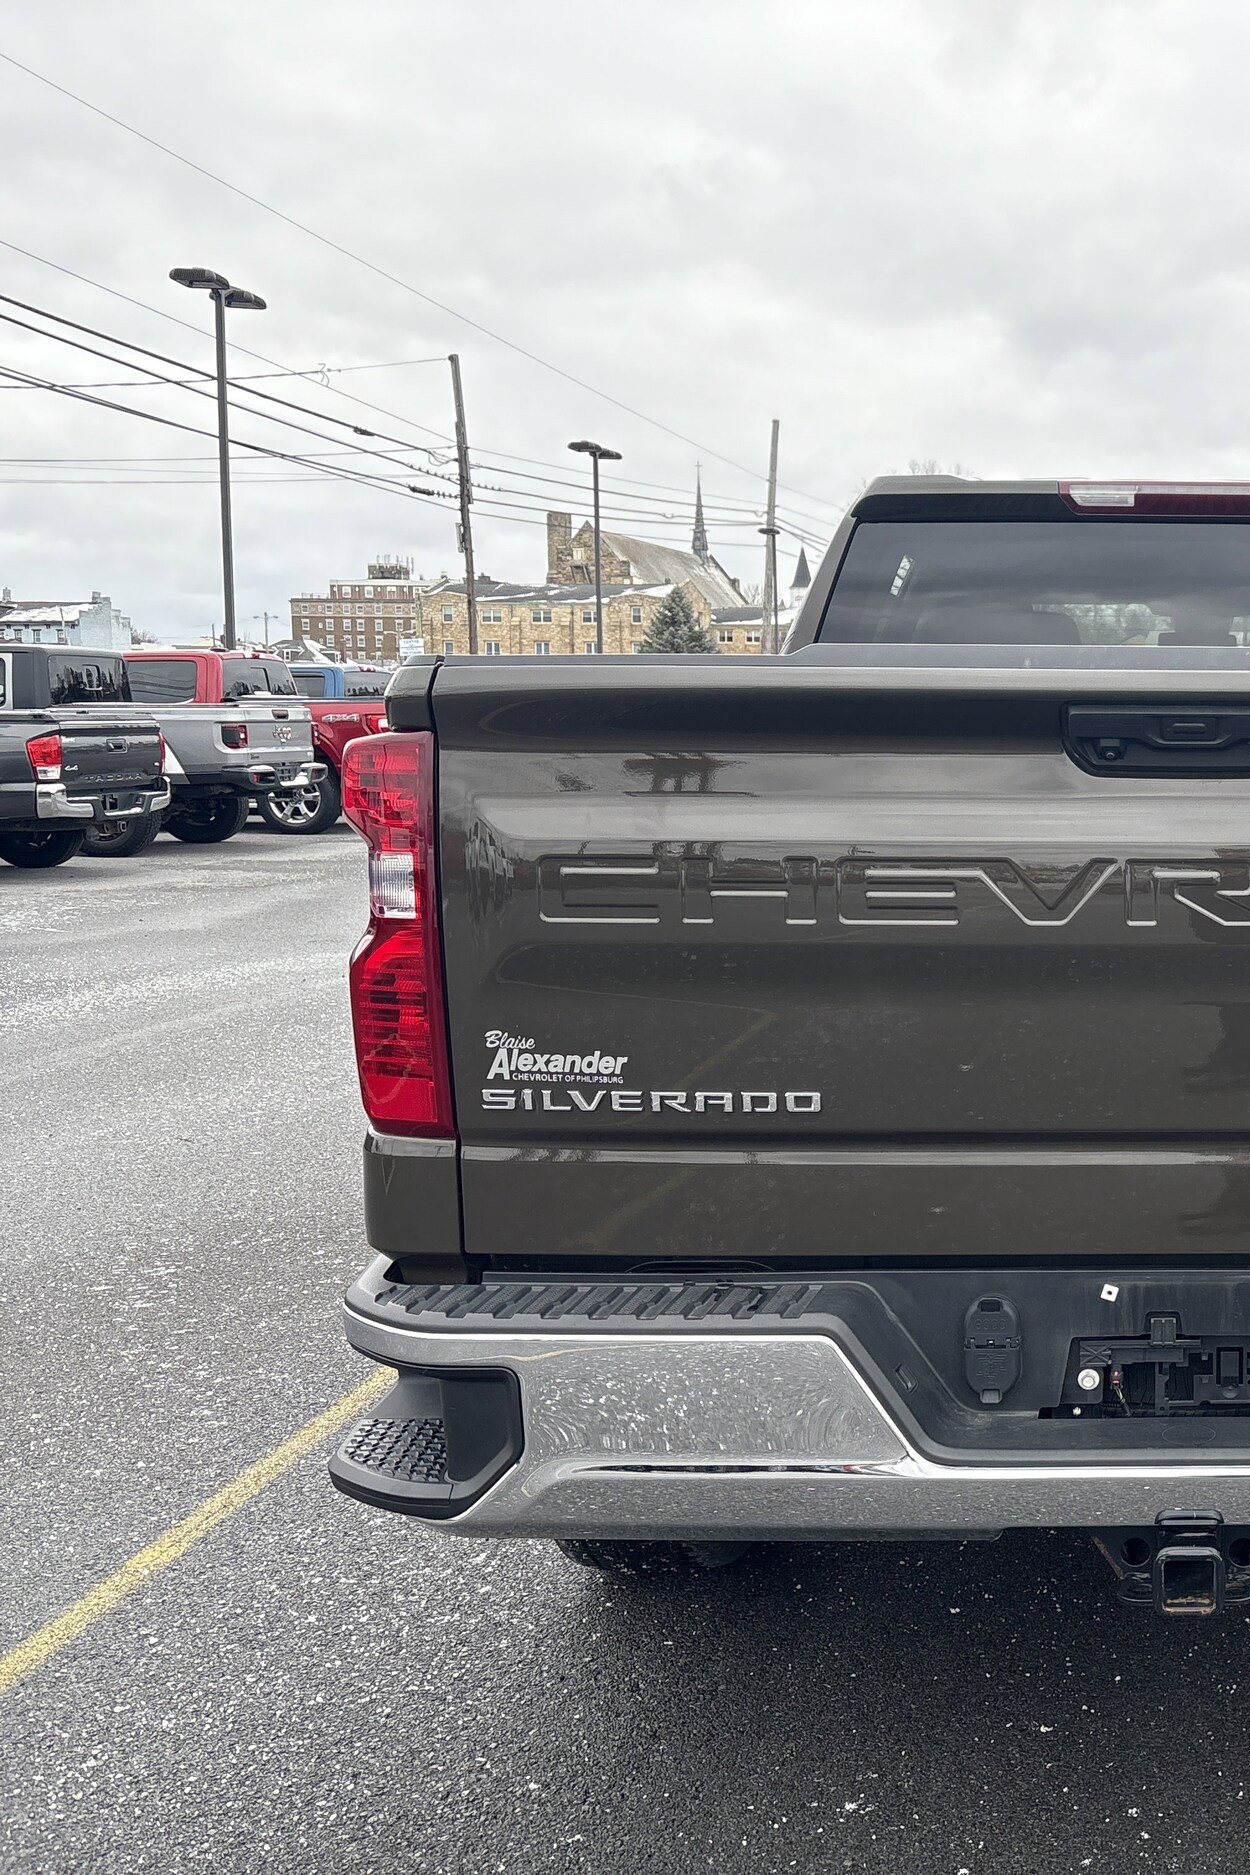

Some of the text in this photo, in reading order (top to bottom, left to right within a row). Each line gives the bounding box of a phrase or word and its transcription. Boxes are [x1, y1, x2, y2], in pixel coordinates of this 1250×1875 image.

[484, 1030, 535, 1049] Blaise
[487, 1048, 628, 1080] Alexander
[512, 1072, 624, 1085] CHEVROLET OF PHILIPSBURG
[481, 1088, 822, 1113] SILVERADO
